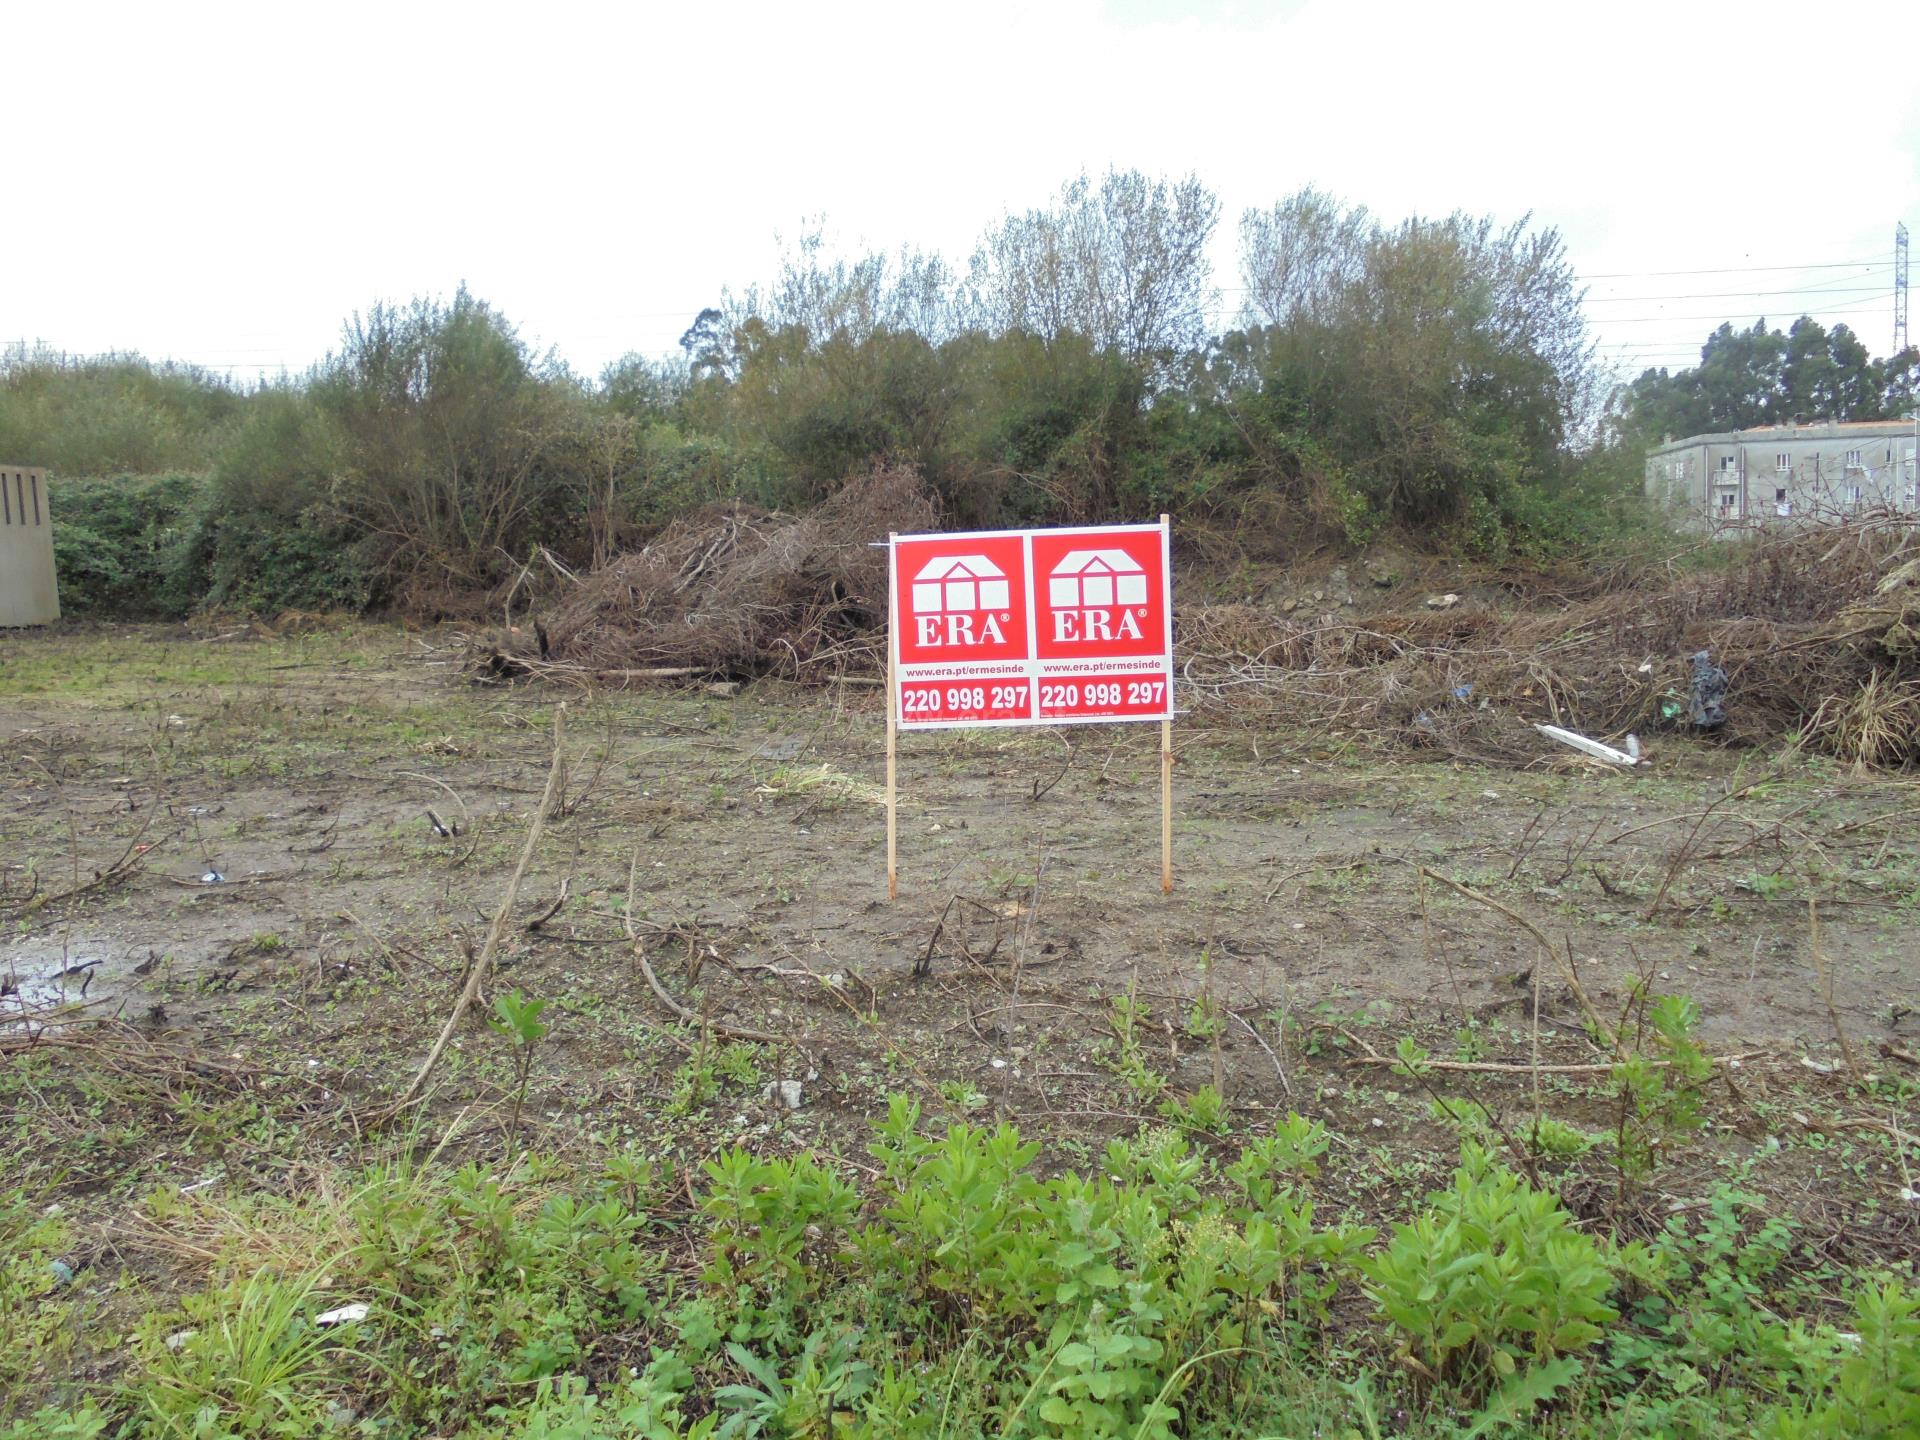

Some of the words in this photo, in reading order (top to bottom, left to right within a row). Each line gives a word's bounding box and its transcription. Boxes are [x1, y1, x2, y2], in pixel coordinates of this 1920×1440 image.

[906, 664, 1024, 677] www.era.pt/ermesinde
[1043, 660, 1161, 673] www.era.pt/ermesinde
[904, 689, 940, 712] 220
[947, 687, 985, 710] 998
[991, 686, 1028, 709] 297
[1041, 685, 1078, 707] 220
[1084, 683, 1121, 706] 998
[1127, 682, 1165, 704] 297
